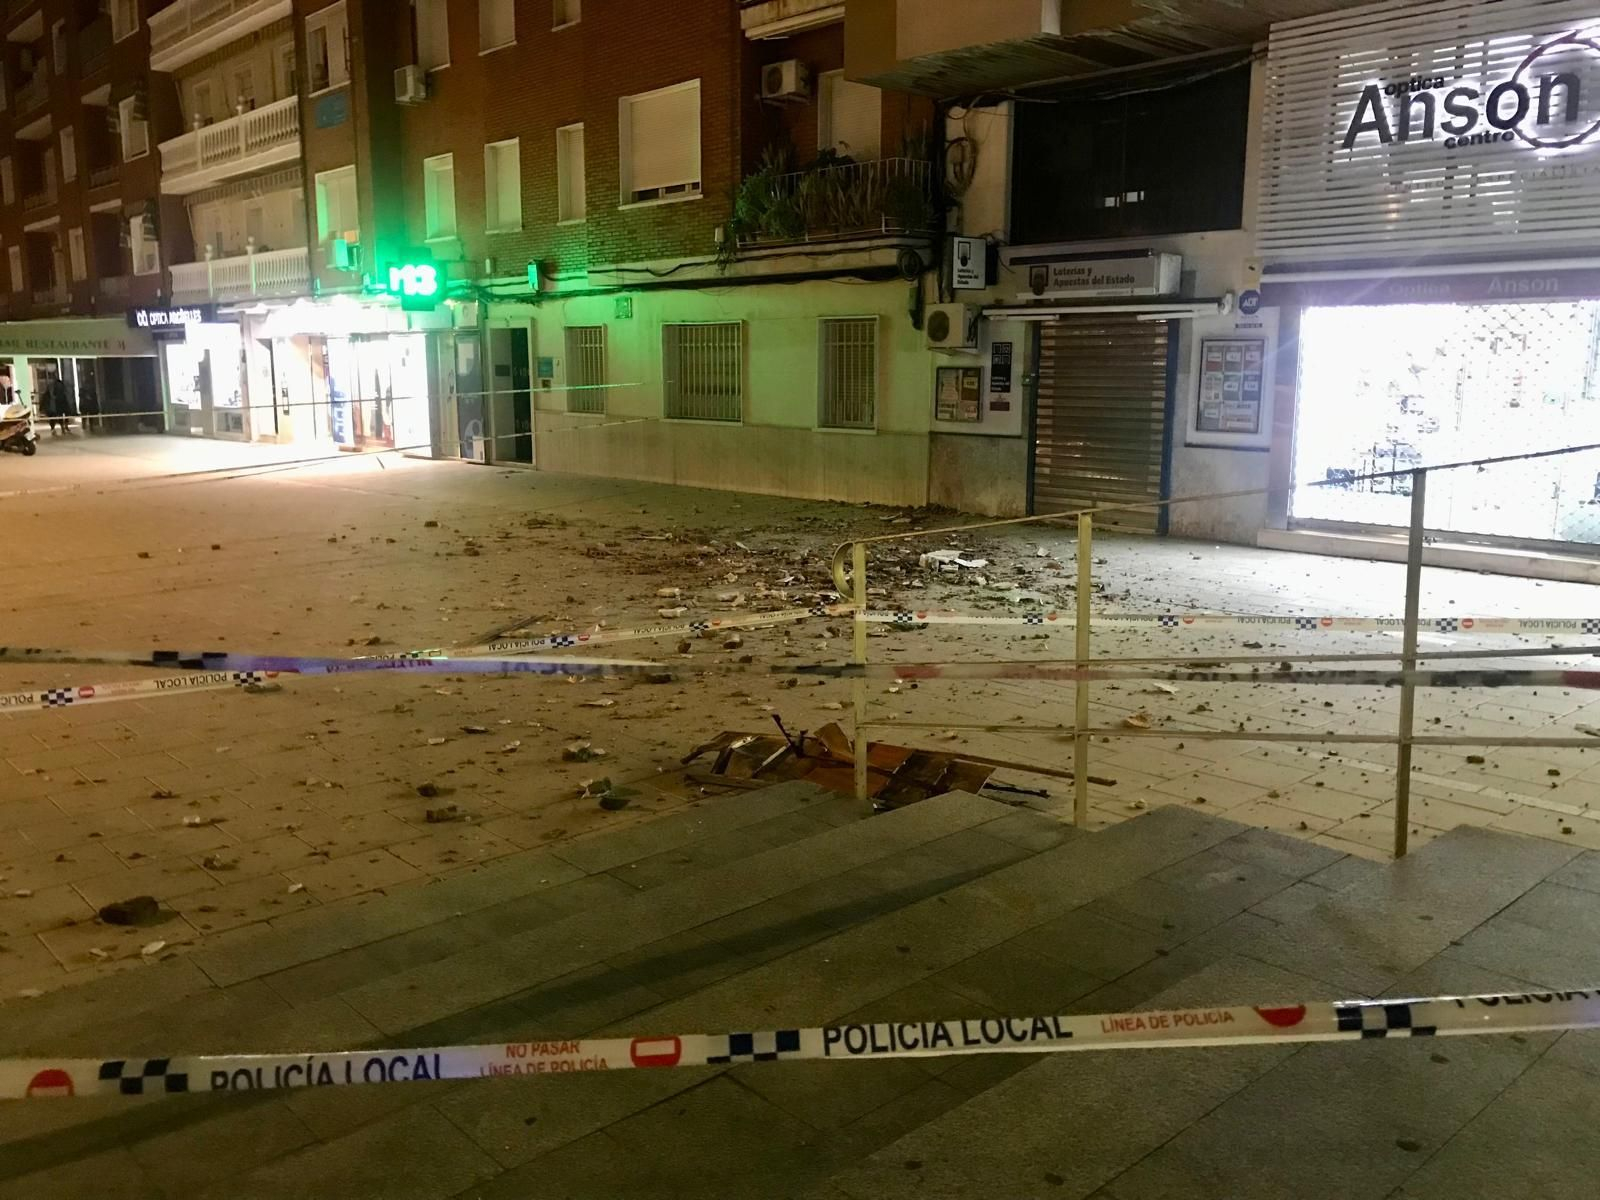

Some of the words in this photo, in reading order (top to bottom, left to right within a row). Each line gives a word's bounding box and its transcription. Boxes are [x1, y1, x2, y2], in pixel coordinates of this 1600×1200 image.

[1341, 72, 1581, 150] Anson
[1443, 130, 1516, 150] centro
[1091, 275, 1105, 286] del
[1106, 273, 1135, 285] Estado
[1487, 277, 1560, 295] Anson
[153, 677, 187, 689] LOCAL
[961, 1015, 1073, 1046] LOCAL
[1148, 1015, 1170, 1030] DE
[505, 1044, 528, 1058] NO
[531, 1040, 580, 1057] PASAR
[526, 1061, 546, 1075] DE
